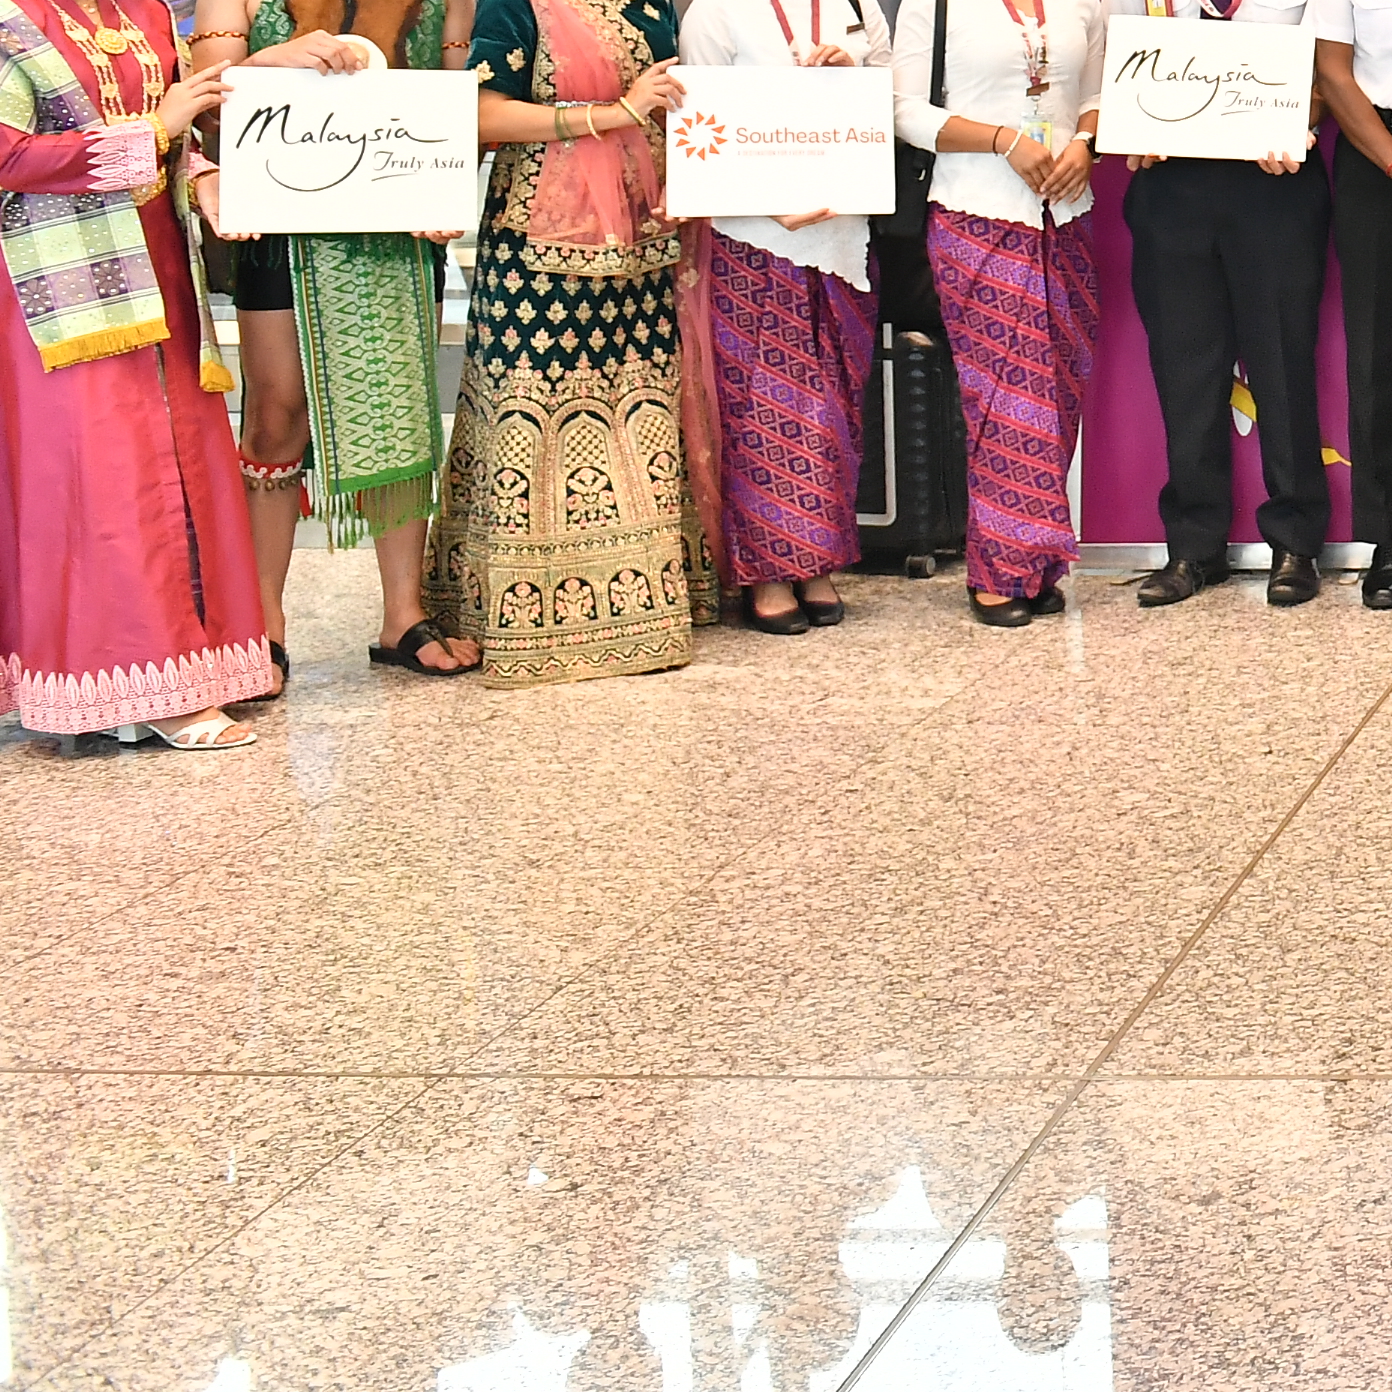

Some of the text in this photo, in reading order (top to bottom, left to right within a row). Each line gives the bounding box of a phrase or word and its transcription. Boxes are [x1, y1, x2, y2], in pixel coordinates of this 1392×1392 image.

[1115, 49, 1287, 122] Malaysia
[1224, 91, 1300, 109] Truly Asia
[736, 127, 886, 144] Southeast Asia
[236, 104, 449, 192] Malaysia
[372, 151, 465, 173] Truly Asia
